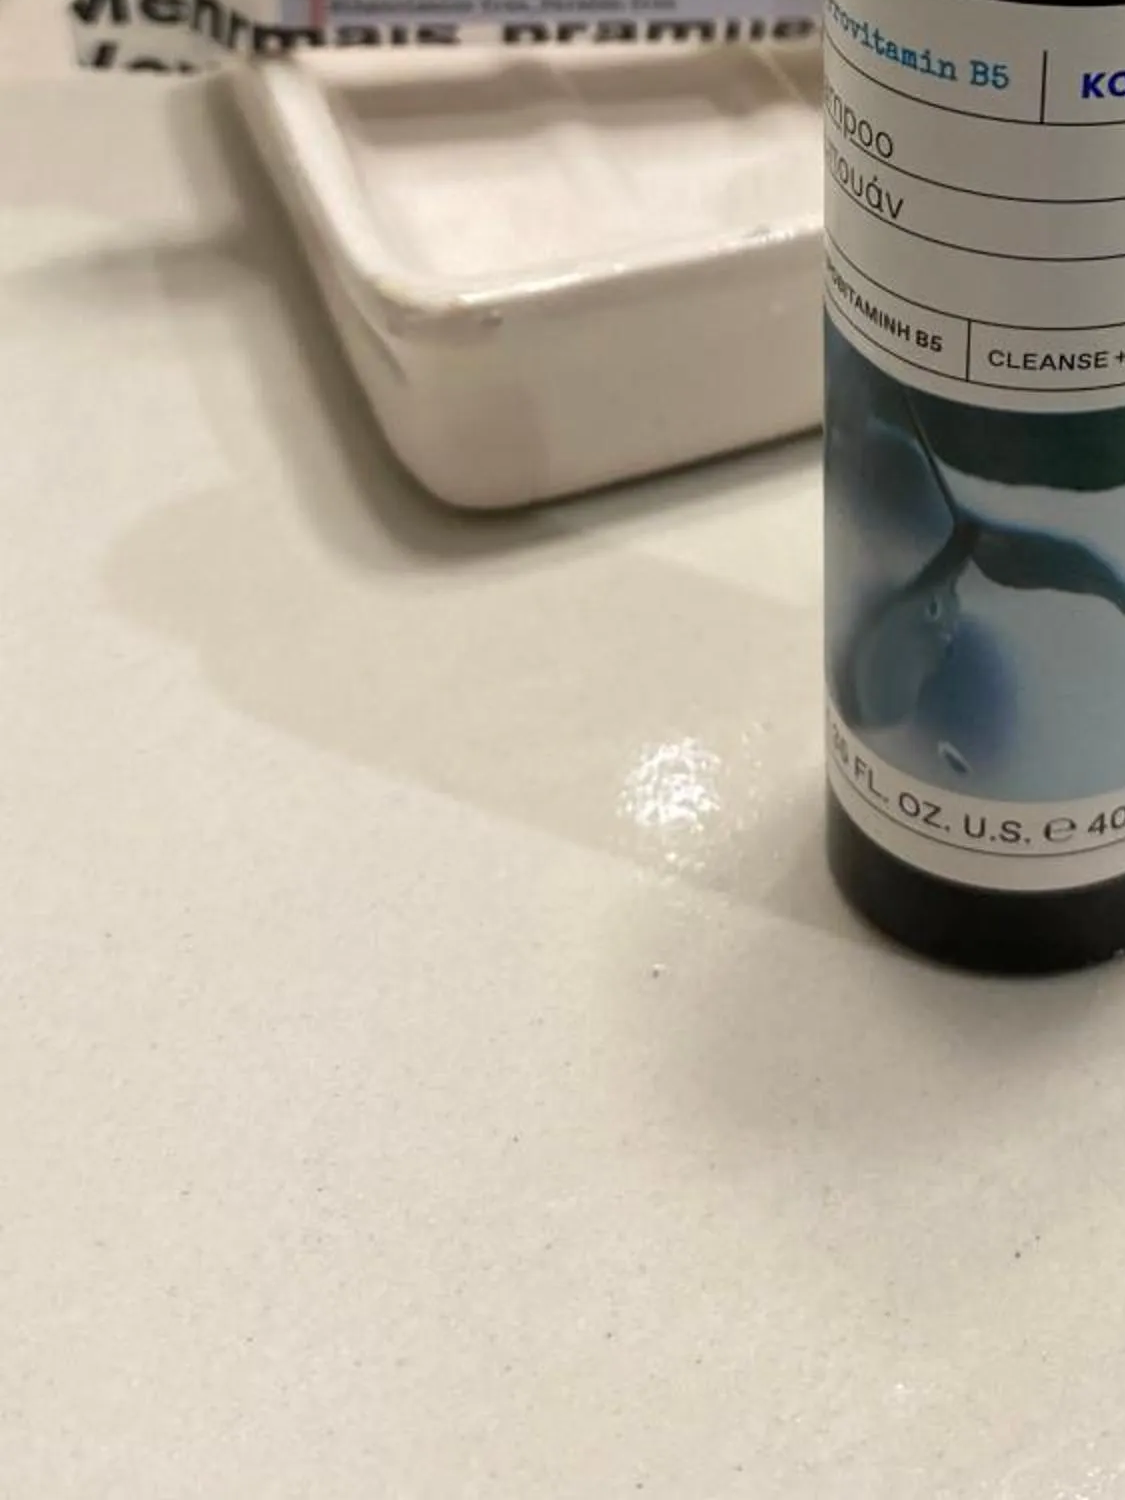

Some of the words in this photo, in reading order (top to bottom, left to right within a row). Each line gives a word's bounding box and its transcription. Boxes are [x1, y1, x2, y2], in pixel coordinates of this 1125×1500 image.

[969, 59, 1010, 90] B5
[915, 328, 944, 354] B5
[987, 348, 1110, 372] CLEANSE
[898, 791, 952, 834] OZ.
[963, 815, 1032, 846] U.S.
